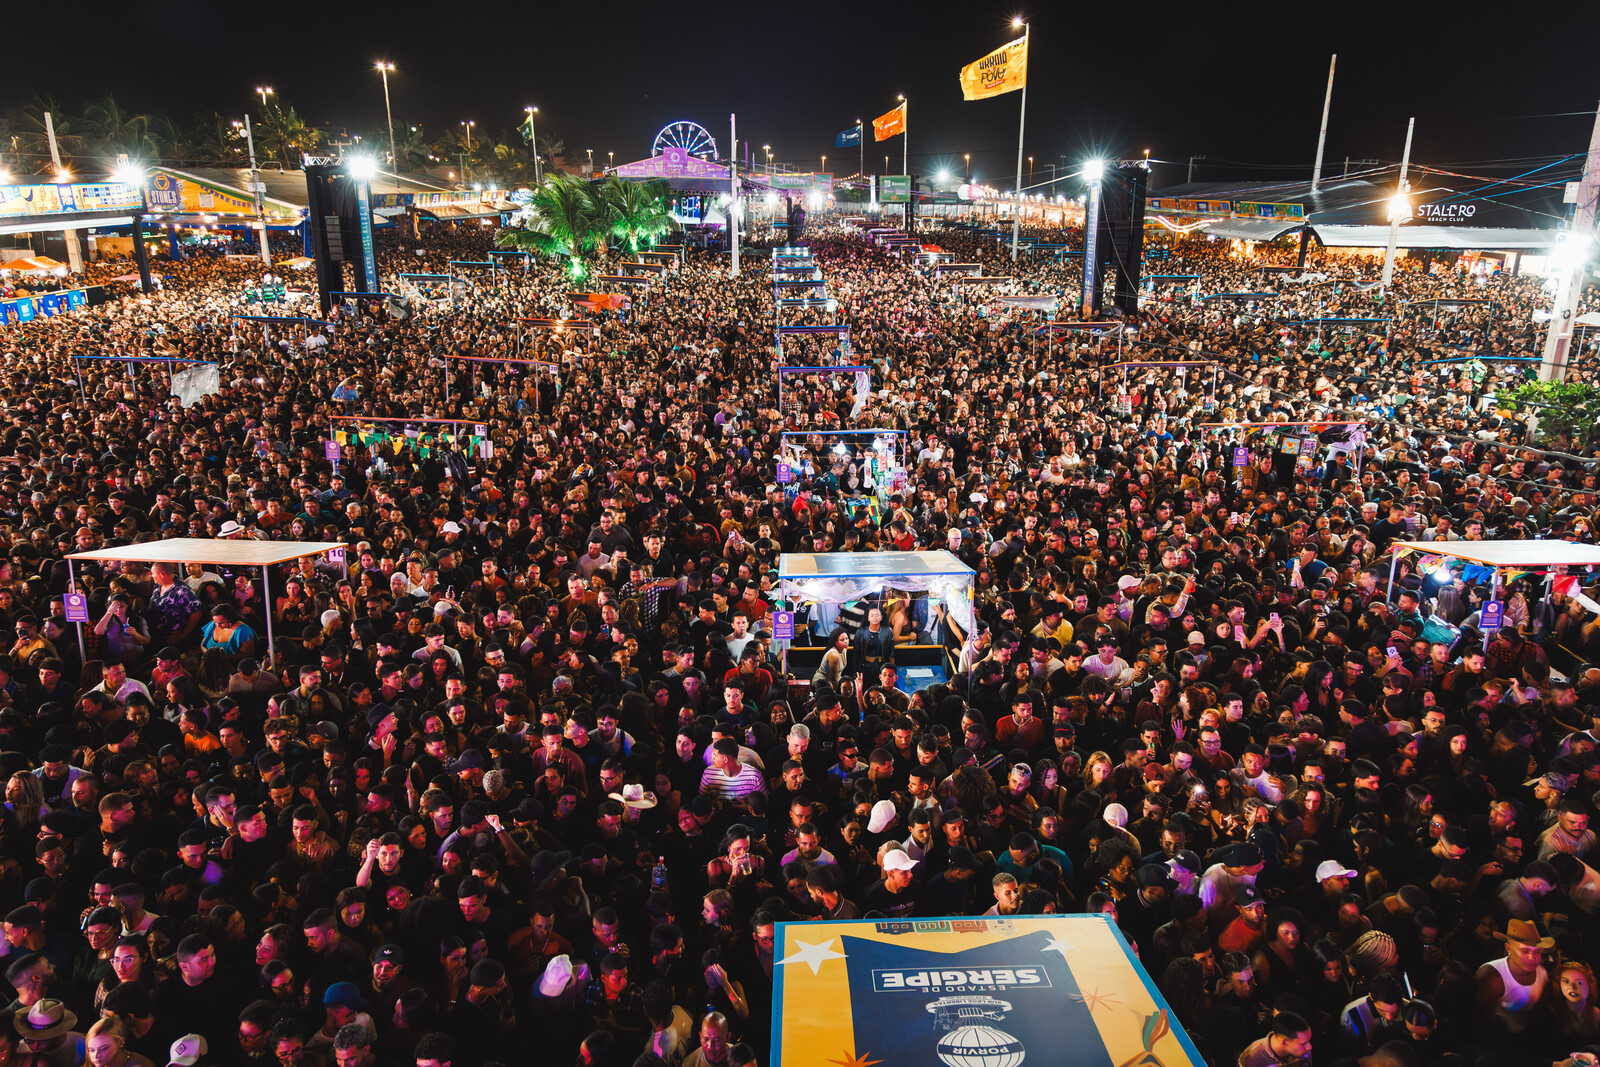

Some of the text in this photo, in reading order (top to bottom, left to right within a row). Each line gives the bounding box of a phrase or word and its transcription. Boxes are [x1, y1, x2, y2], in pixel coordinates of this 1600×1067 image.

[151, 191, 177, 204] STONES
[331, 549, 344, 558] 10
[881, 969, 1041, 987] SERGIPE
[951, 1046, 1009, 1055] PORVIR
